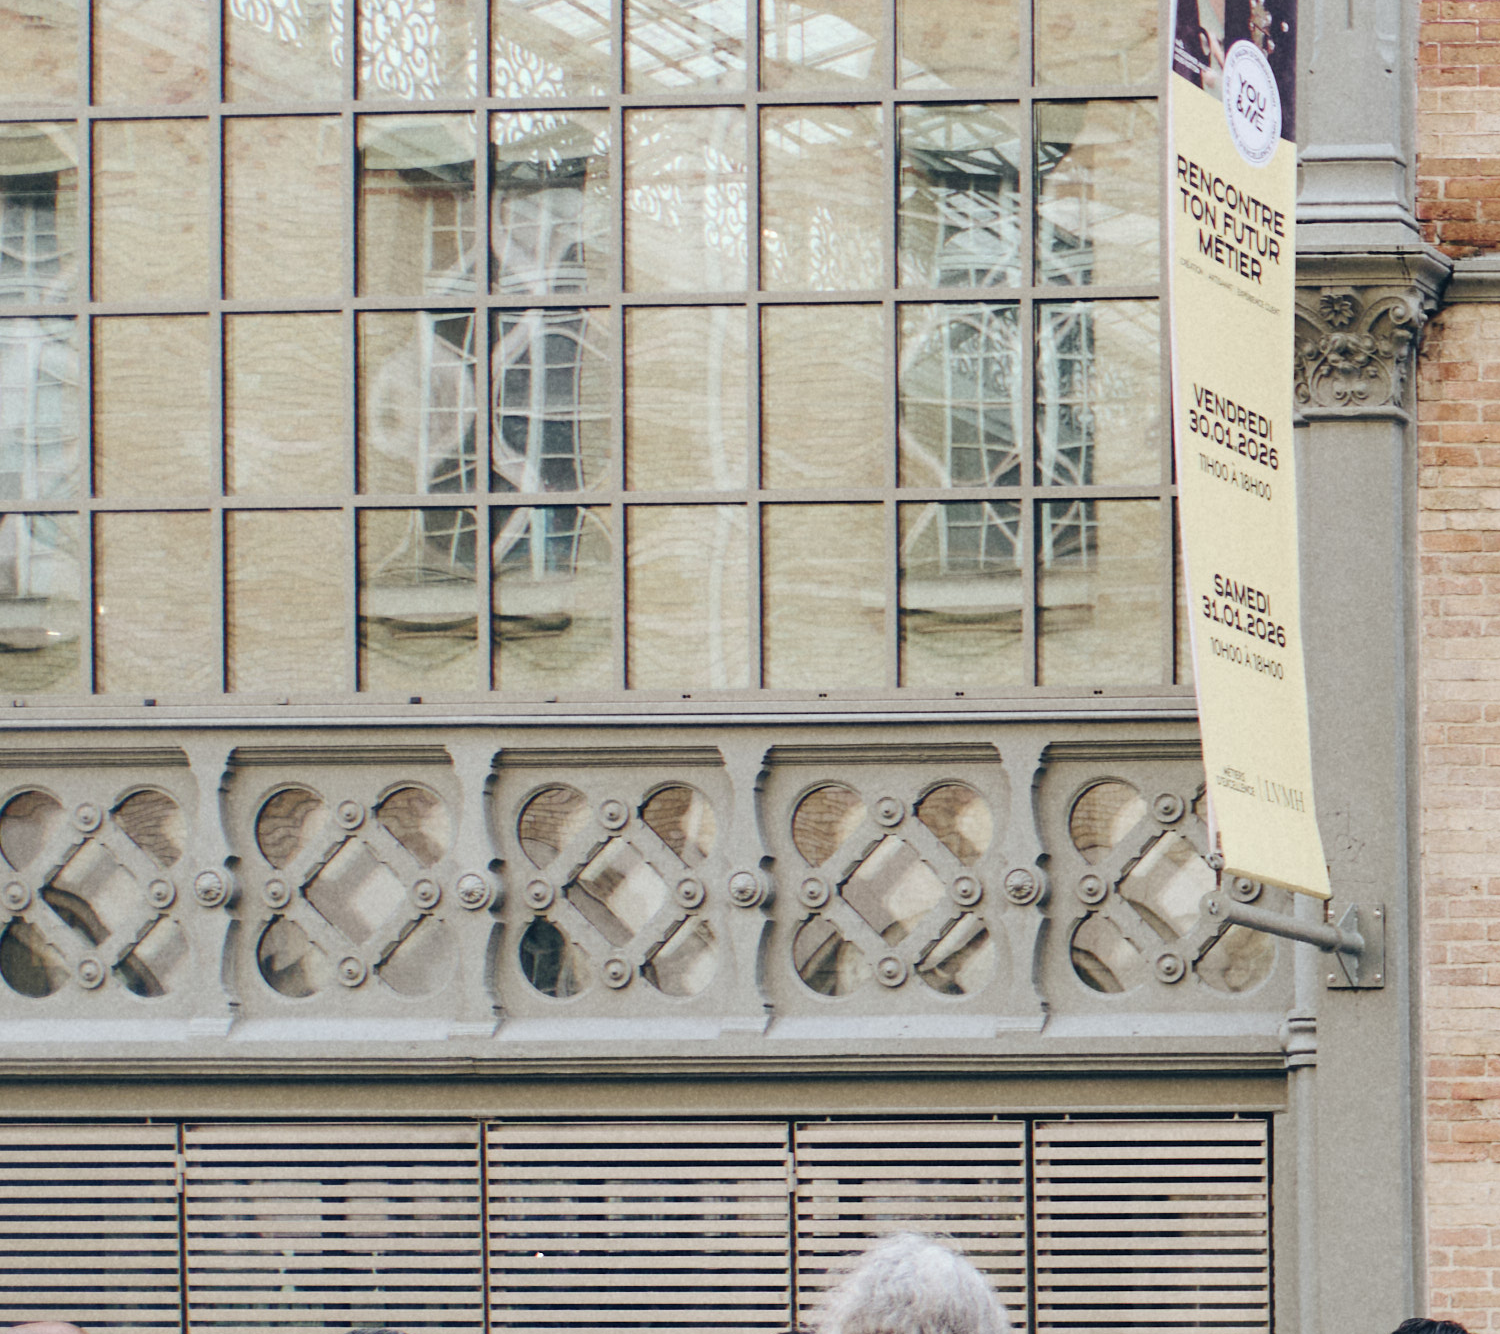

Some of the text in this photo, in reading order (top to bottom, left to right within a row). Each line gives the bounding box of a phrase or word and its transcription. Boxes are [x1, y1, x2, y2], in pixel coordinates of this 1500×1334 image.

[1177, 154, 1285, 238] RENCONTRE
[1180, 187, 1280, 265] TON FUTUR
[1199, 228, 1262, 285] MÉTIER
[1189, 409, 1279, 470] 30.01.2026
[1193, 383, 1273, 442] VENDREDI
[1199, 452, 1229, 481] 11H00
[1240, 471, 1272, 501] 18H00
[1202, 595, 1286, 648] 31.01.2026
[1214, 573, 1271, 616] SAMEDI
[1210, 636, 1242, 664] 10H00
[1252, 653, 1284, 680] 18H00
[1265, 779, 1305, 813] LVMH
